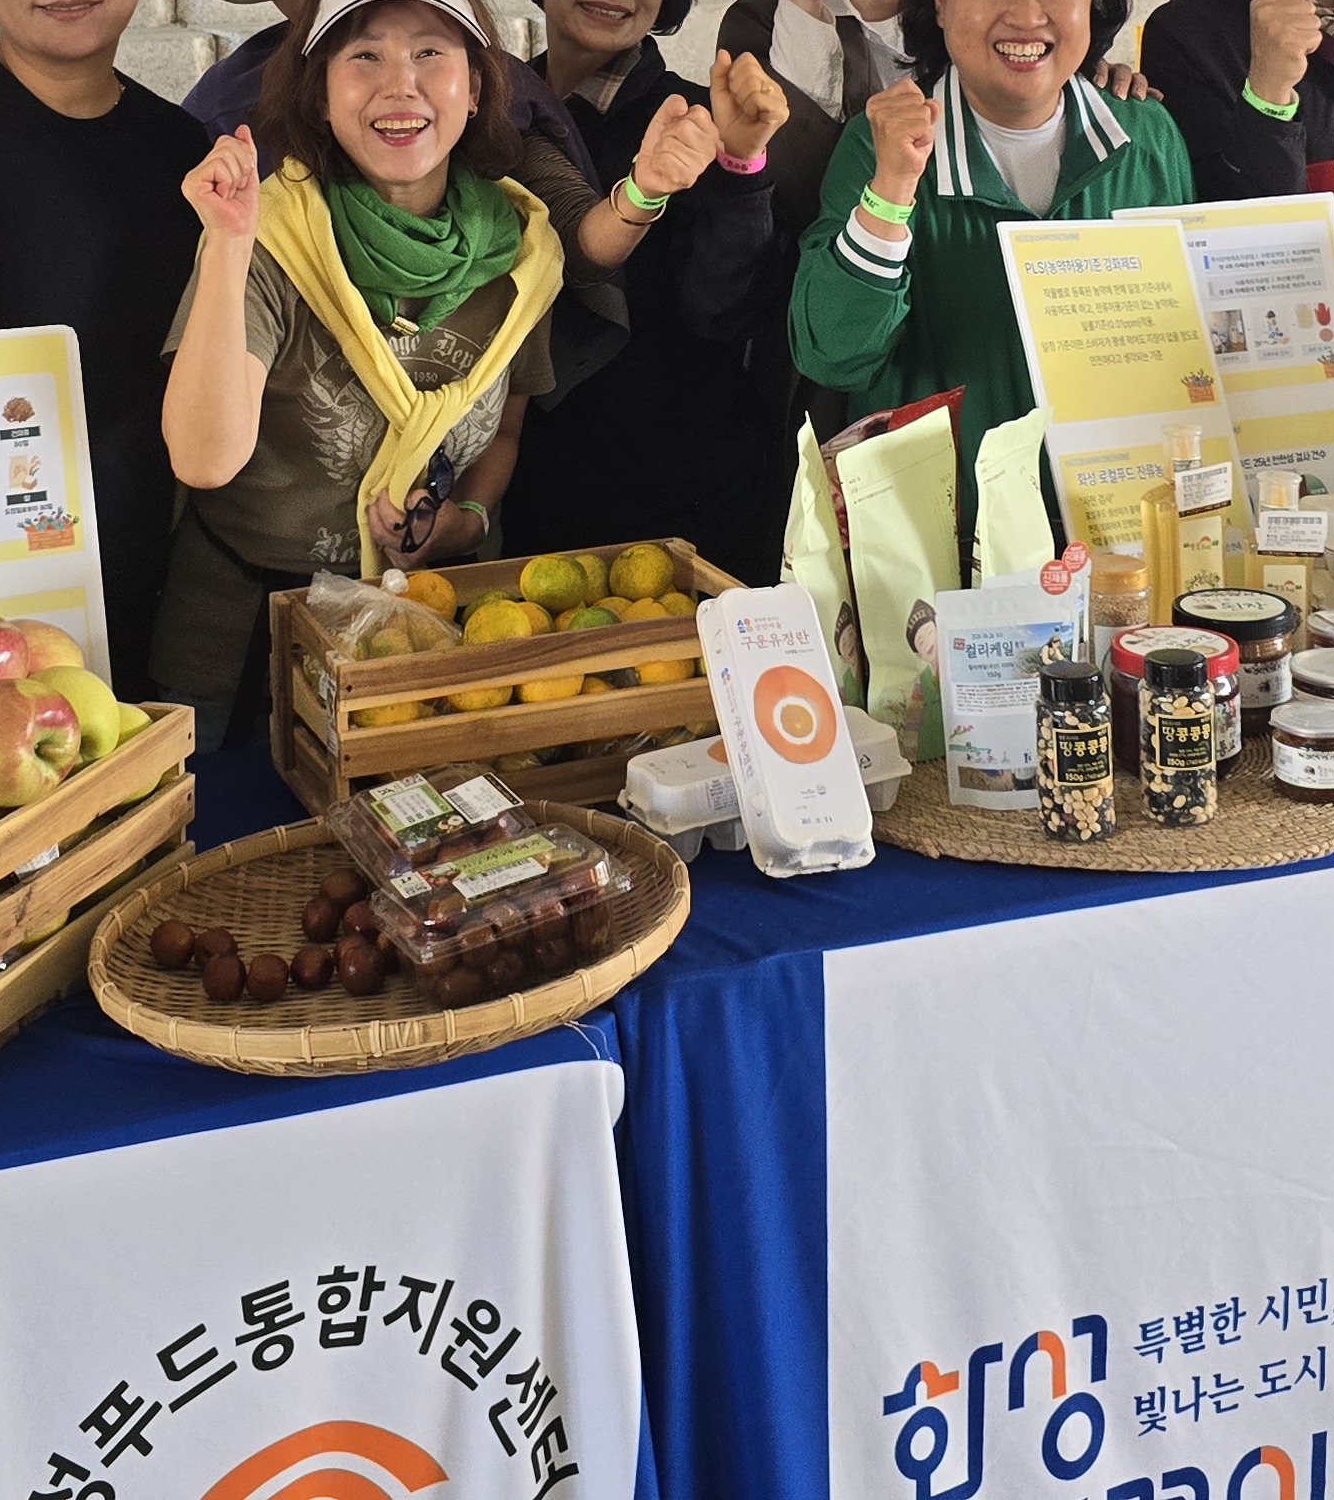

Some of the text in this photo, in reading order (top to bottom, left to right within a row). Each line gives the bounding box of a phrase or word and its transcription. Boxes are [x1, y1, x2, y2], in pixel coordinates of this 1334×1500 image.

[1077, 469, 1097, 486] 화성
[1099, 466, 1135, 483] 로컬푸드
[741, 629, 810, 650] 구운유정란
[966, 641, 1015, 659] 컬리케일
[1162, 723, 1210, 742] 땅콩콩콩
[1059, 736, 1108, 757] 땅콩콩콩
[1167, 758, 1185, 767] 150g
[1065, 772, 1083, 782] 150g
[1133, 1296, 1247, 1364] 특별한
[1133, 1345, 1328, 1437] 빛나는 도시
[882, 1313, 1108, 1500] 화성
